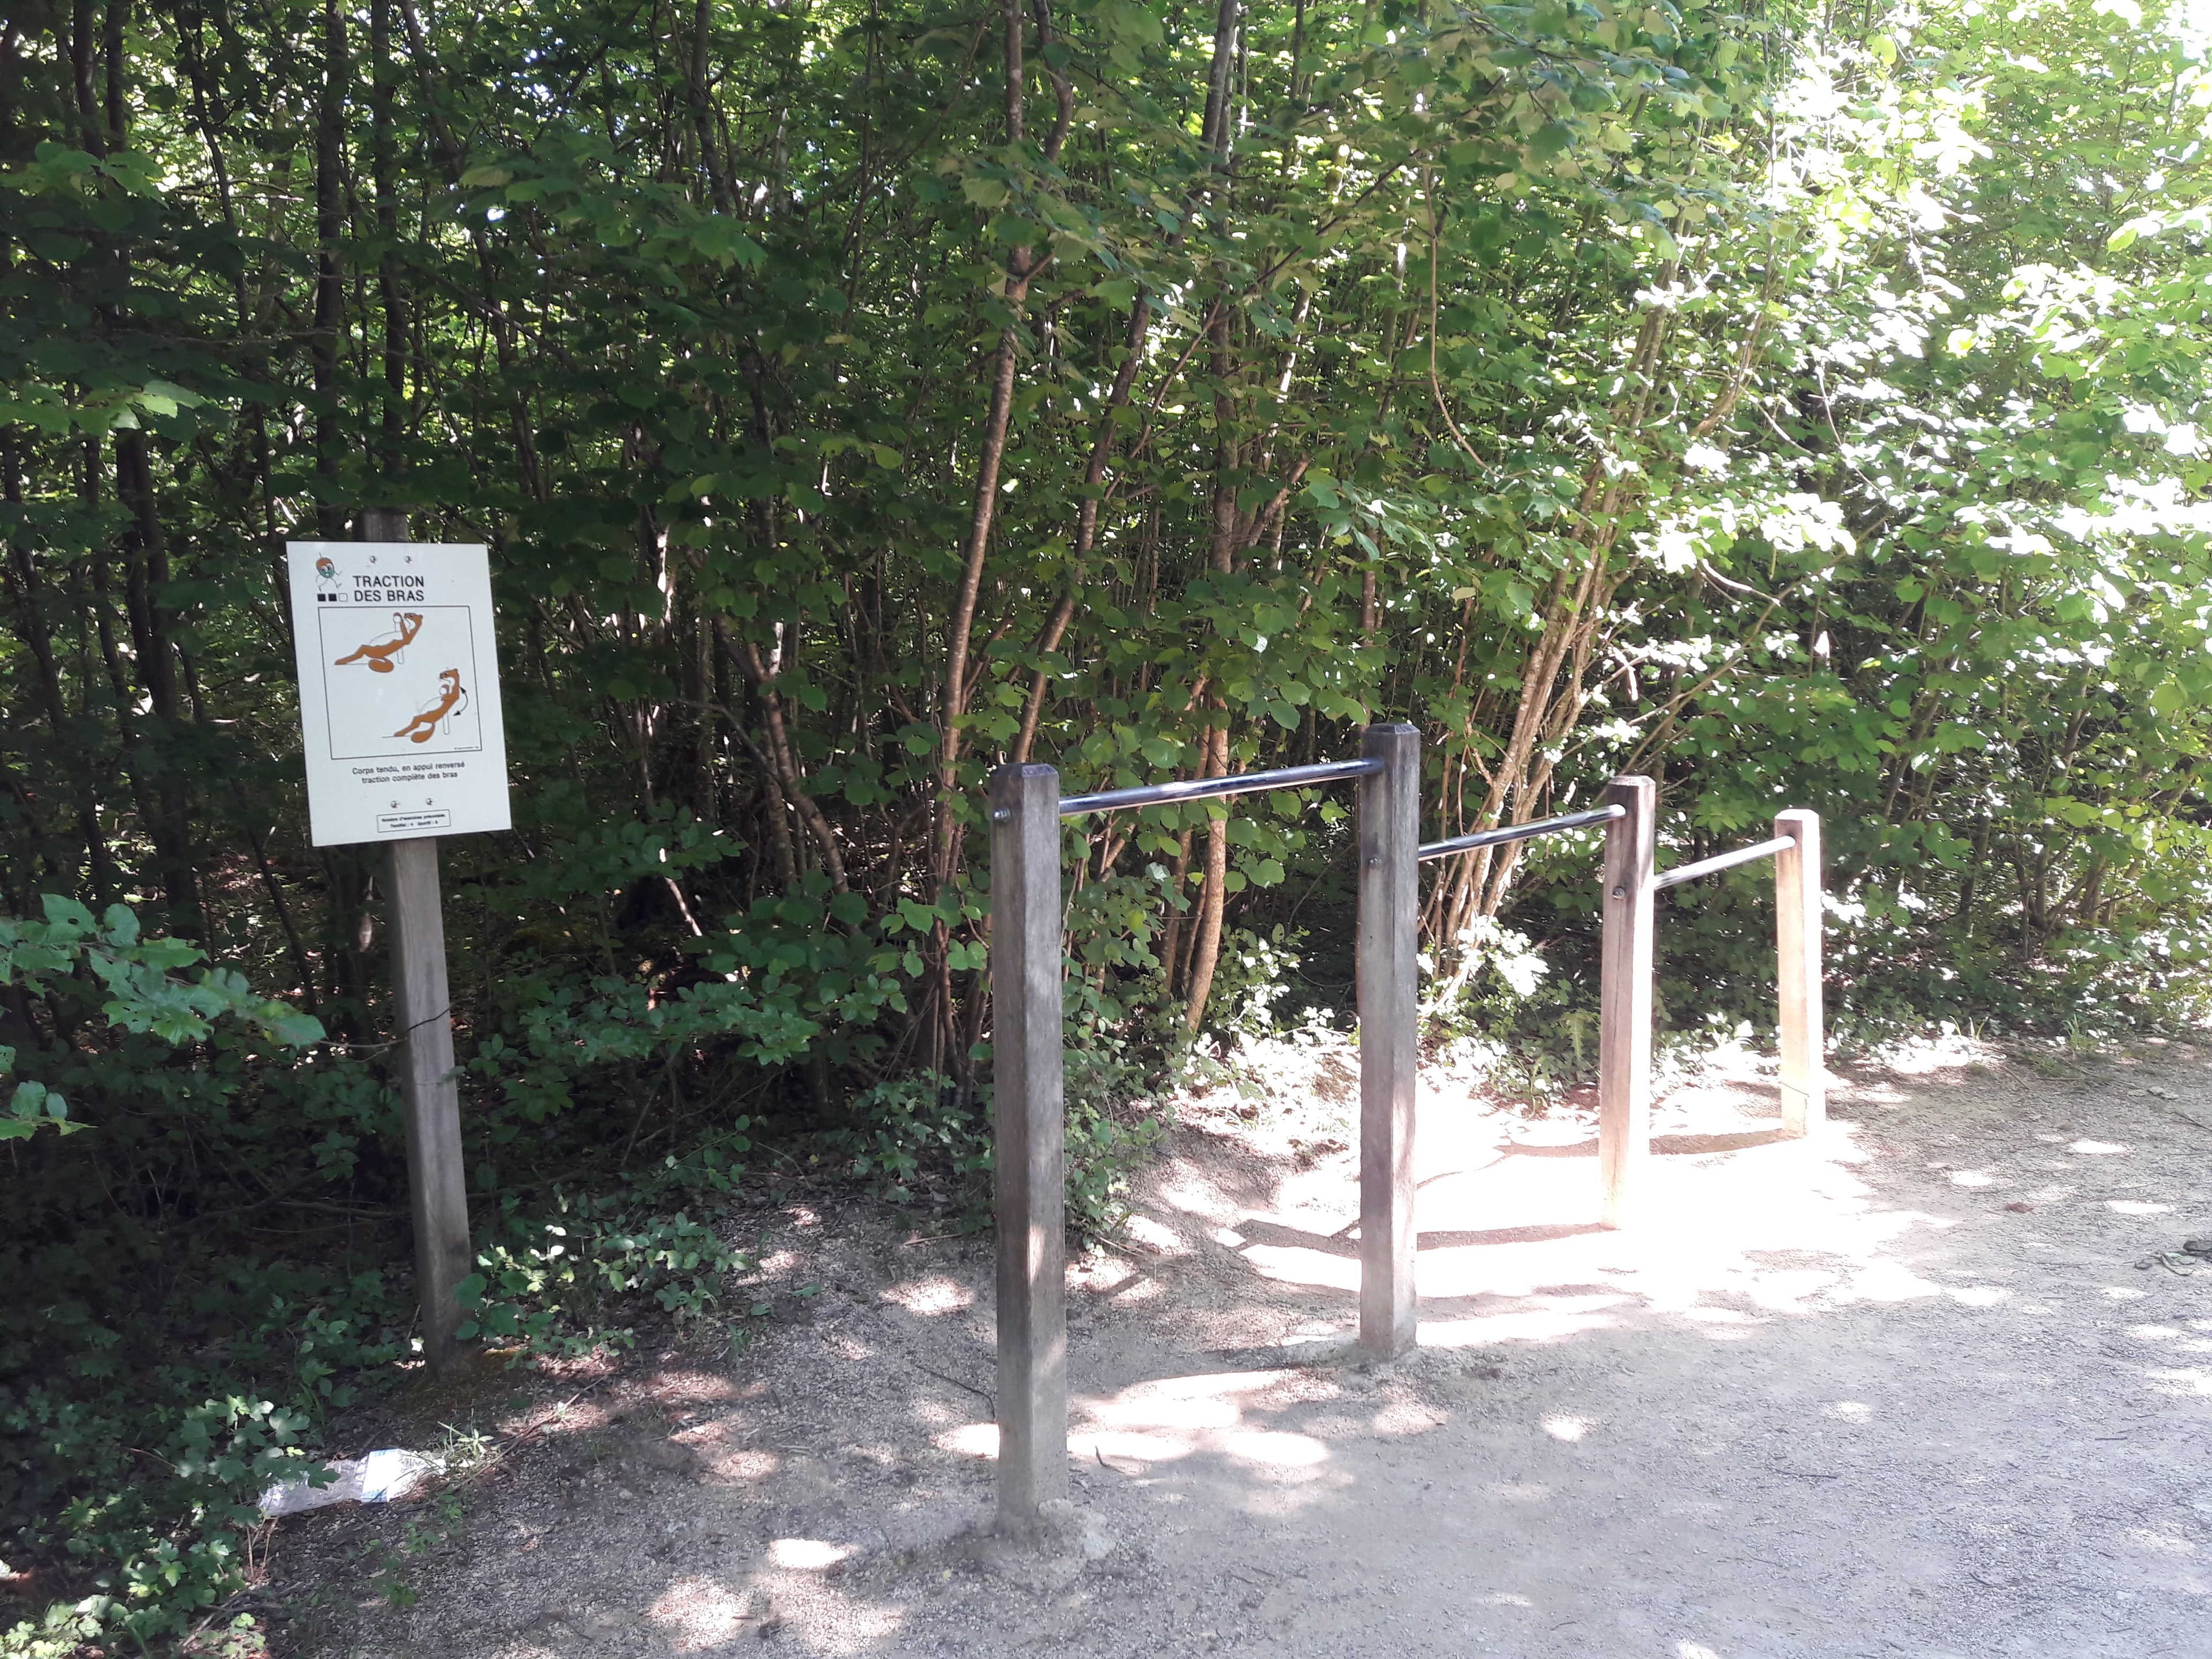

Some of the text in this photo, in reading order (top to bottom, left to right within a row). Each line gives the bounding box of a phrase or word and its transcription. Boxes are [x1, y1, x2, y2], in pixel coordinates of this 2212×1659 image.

[352, 575, 425, 588] TRACTION
[354, 590, 425, 601] DES BRAS
[413, 762, 433, 771] appui
